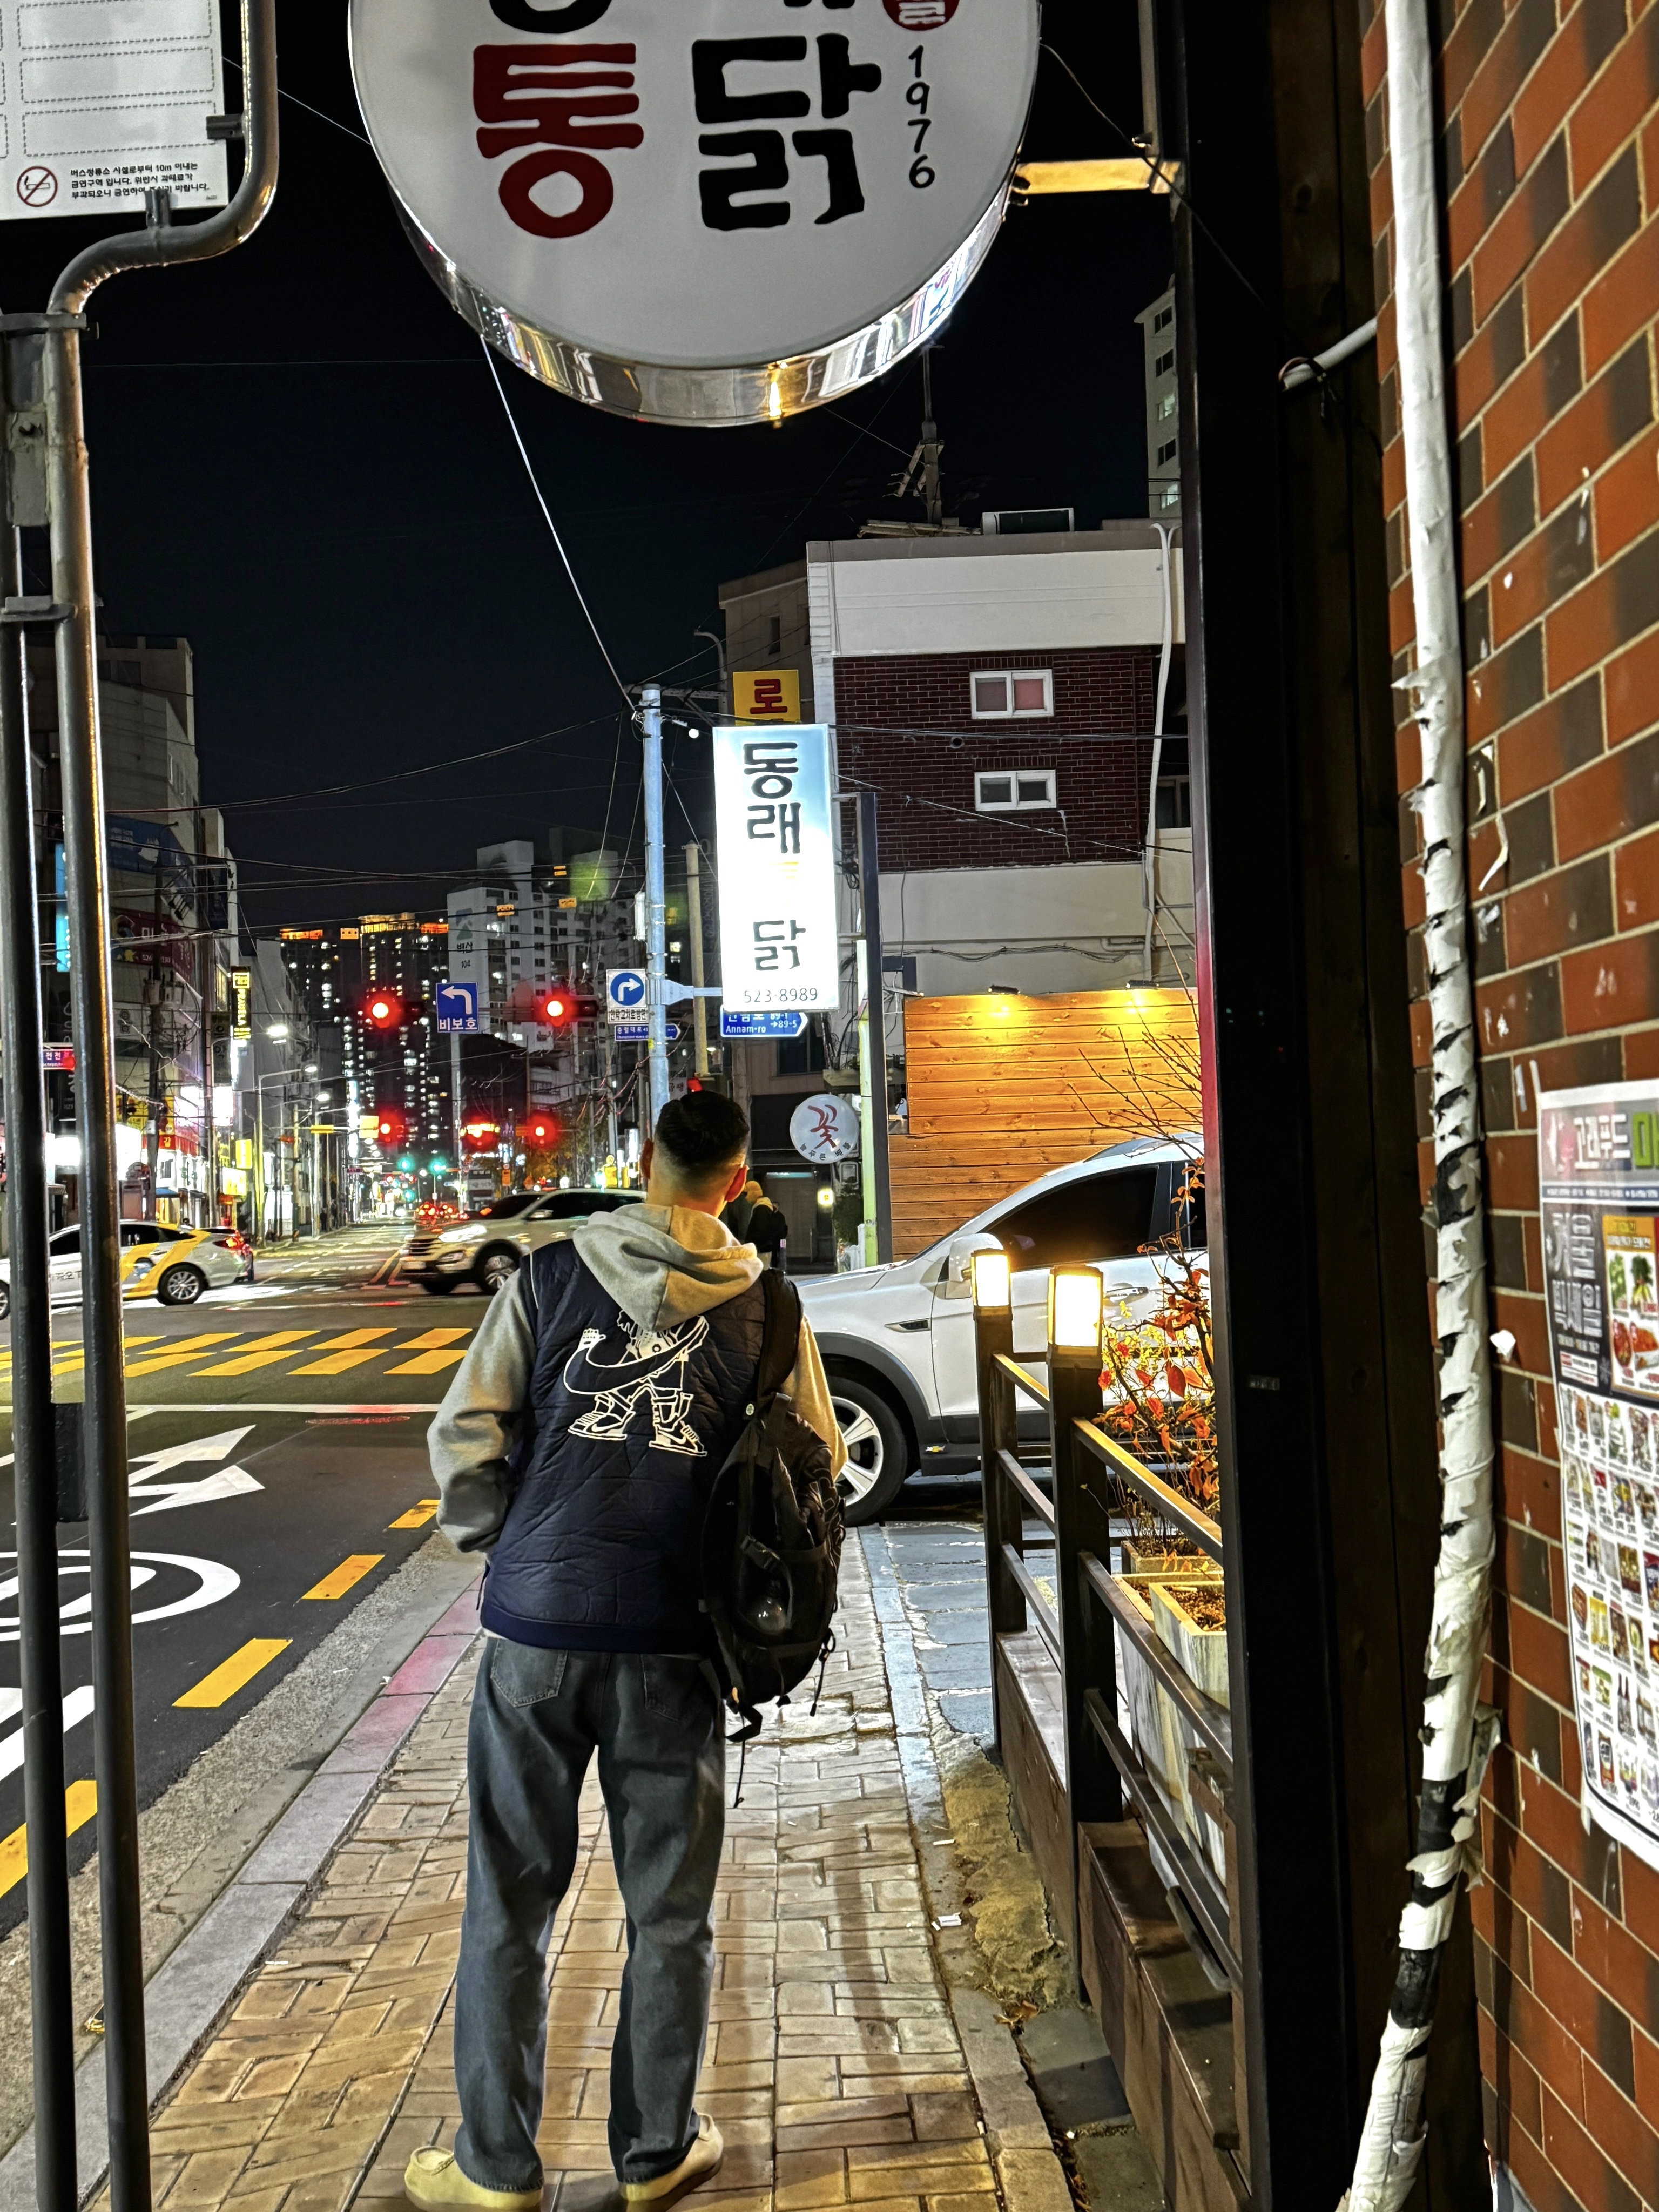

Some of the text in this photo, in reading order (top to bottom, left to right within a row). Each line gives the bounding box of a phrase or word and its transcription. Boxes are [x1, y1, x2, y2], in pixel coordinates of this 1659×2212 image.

[906, 44, 935, 188] 1976
[113, 165, 153, 174] 시설로부터
[175, 162, 198, 171] 이내는
[71, 172, 193, 188] 금연구역 입니다. 위반시 과태료가
[71, 190, 111, 199] 부과되오니
[174, 182, 210, 193] 바랍니다.
[750, 678, 788, 714] 로
[744, 988, 818, 1003] 523-8989
[439, 1017, 477, 1031] 비보호
[726, 1020, 797, 1033] Annam-ro 89-5
[807, 1104, 839, 1150] 꽃
